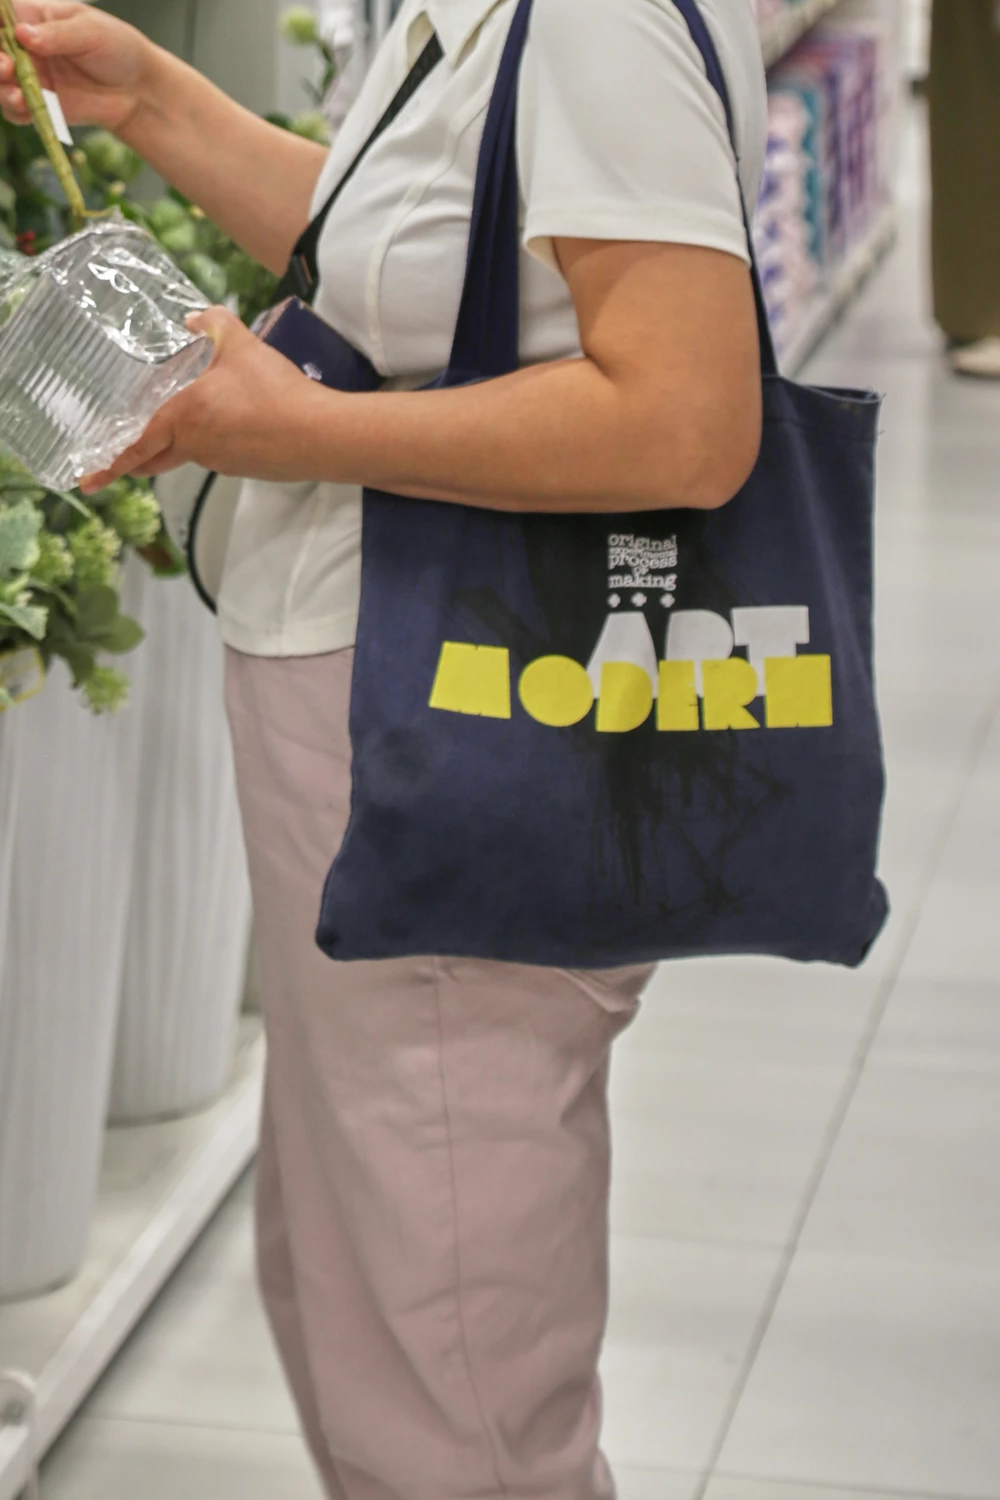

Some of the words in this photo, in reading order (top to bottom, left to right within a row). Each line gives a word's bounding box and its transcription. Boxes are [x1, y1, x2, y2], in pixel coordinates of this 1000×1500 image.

[609, 534, 677, 551] original
[608, 554, 677, 570] process
[633, 566, 649, 576] of
[608, 573, 677, 591] making
